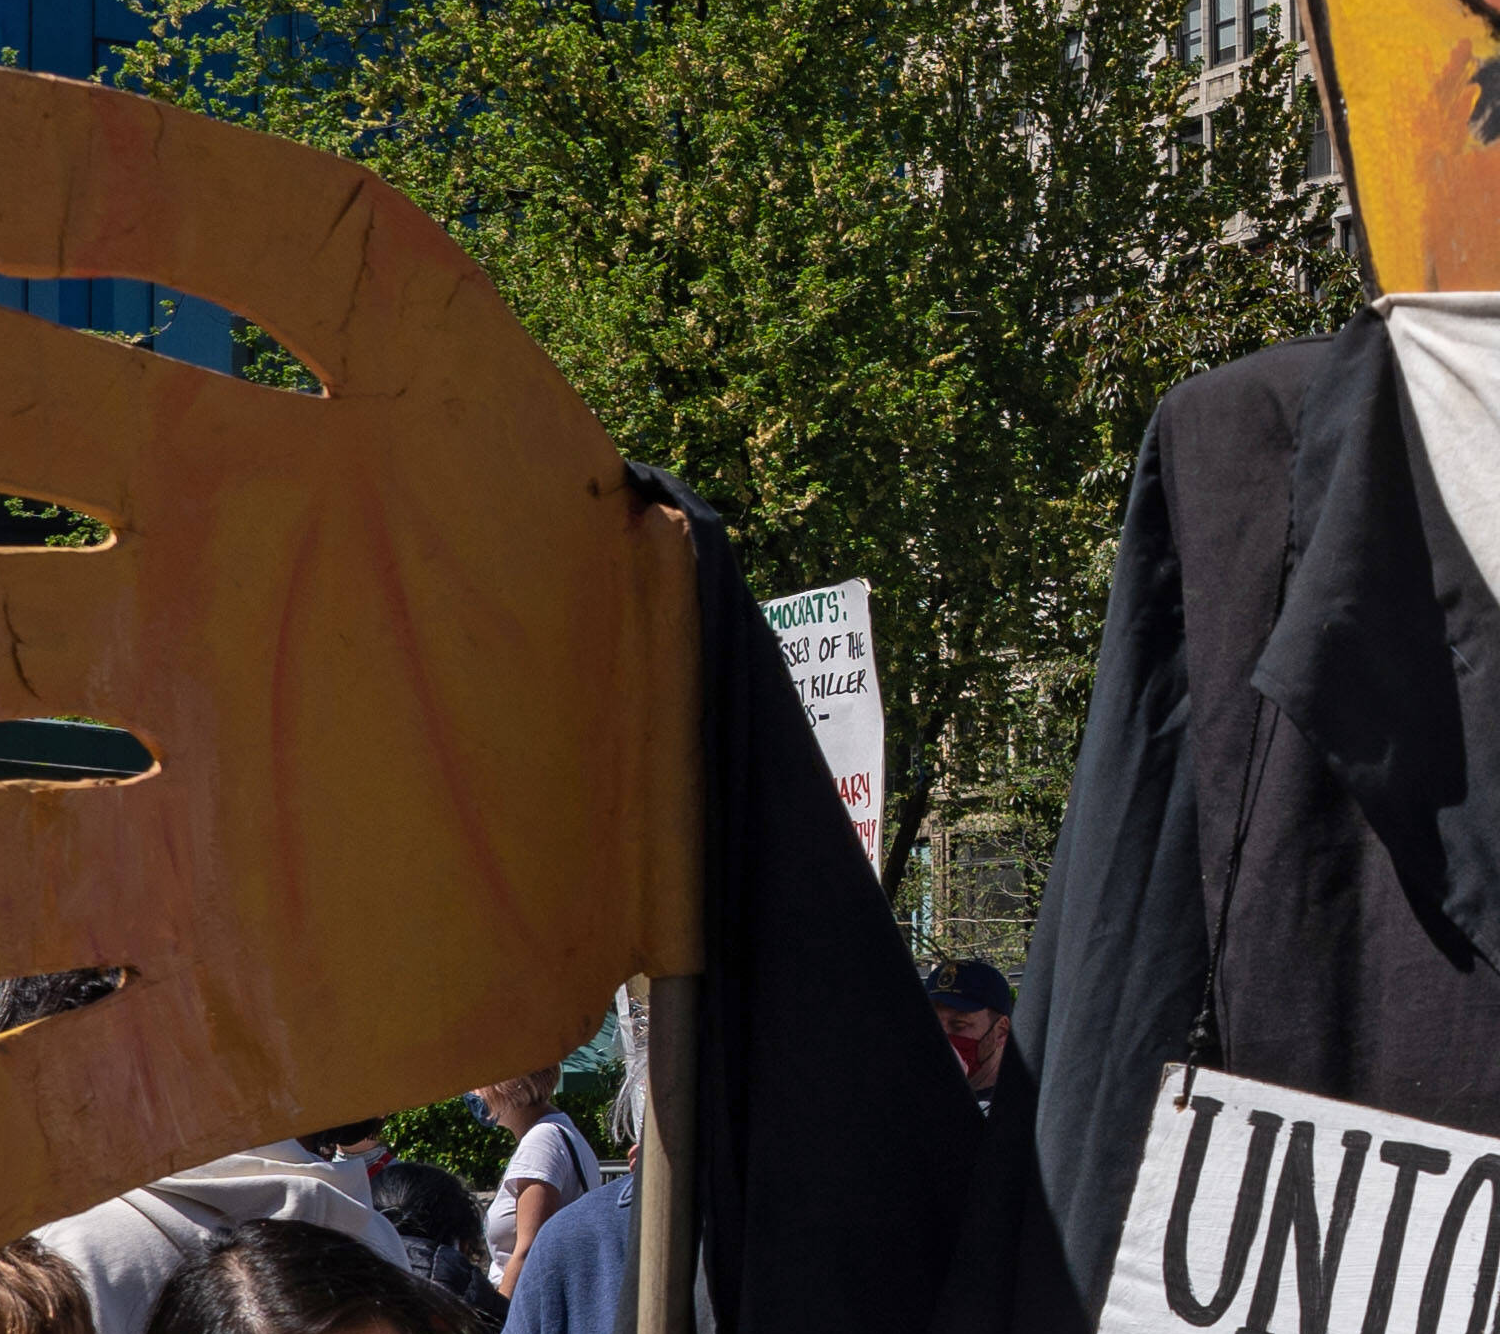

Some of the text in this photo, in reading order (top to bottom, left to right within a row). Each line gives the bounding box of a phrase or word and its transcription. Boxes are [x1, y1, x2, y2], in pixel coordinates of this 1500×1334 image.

[762, 591, 847, 630] MOCRATS:
[819, 635, 842, 663] OF
[846, 631, 866, 660] THE
[811, 669, 868, 699] KILLER
[833, 772, 872, 808] ARY
